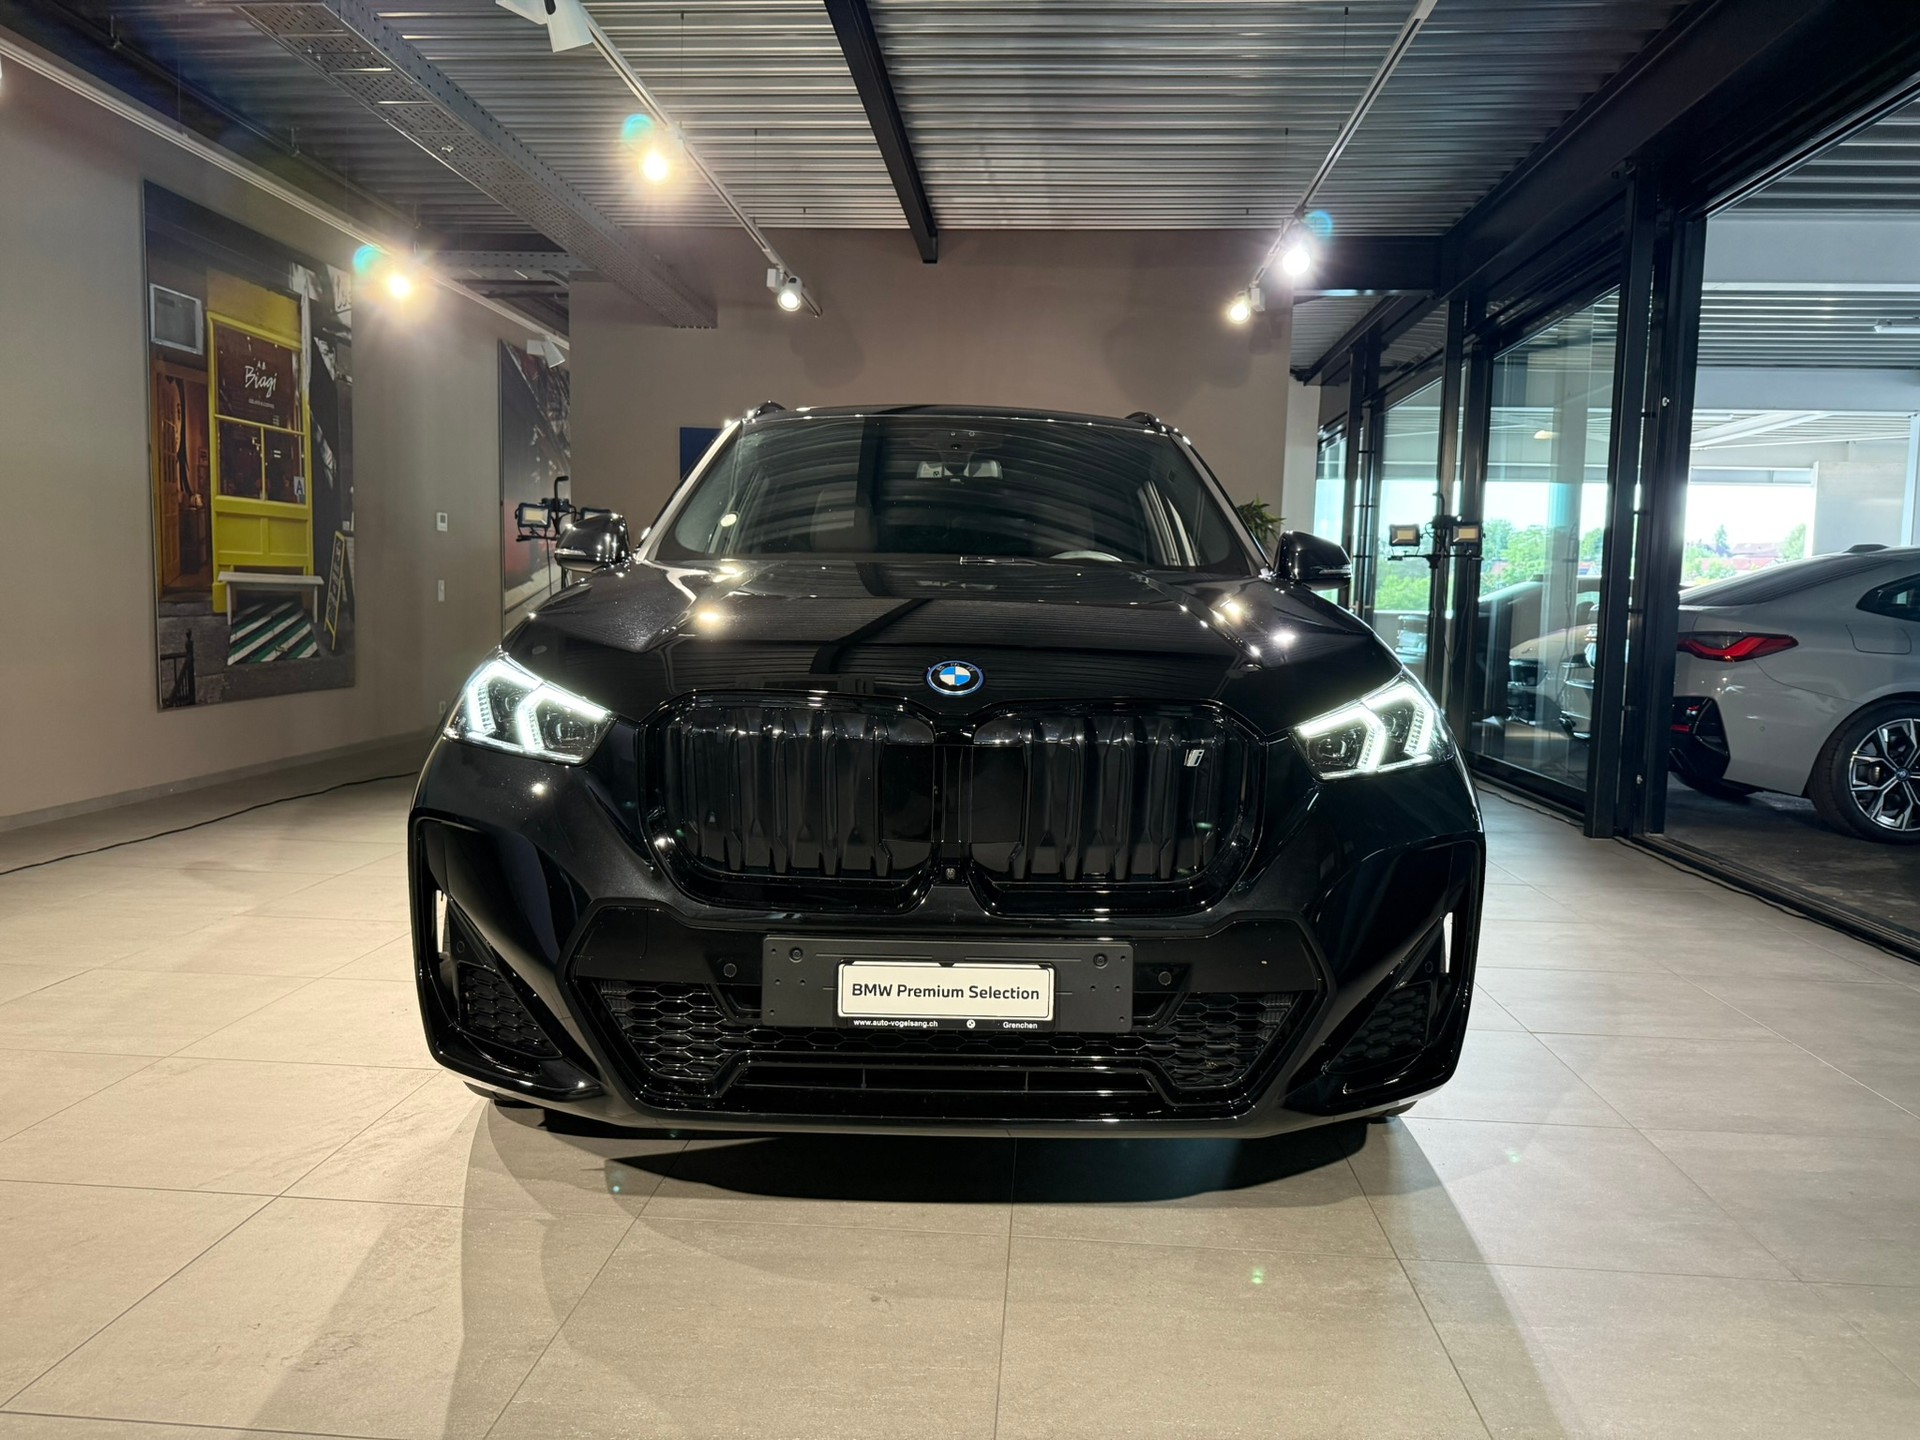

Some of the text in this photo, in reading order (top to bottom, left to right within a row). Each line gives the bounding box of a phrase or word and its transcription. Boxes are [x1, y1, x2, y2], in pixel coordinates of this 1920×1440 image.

[244, 365, 278, 398] Biagi
[852, 983, 1040, 1000] BMW Premium Selection
[853, 1019, 1038, 1030] www.auto-vogelsang.ch Grenchen
